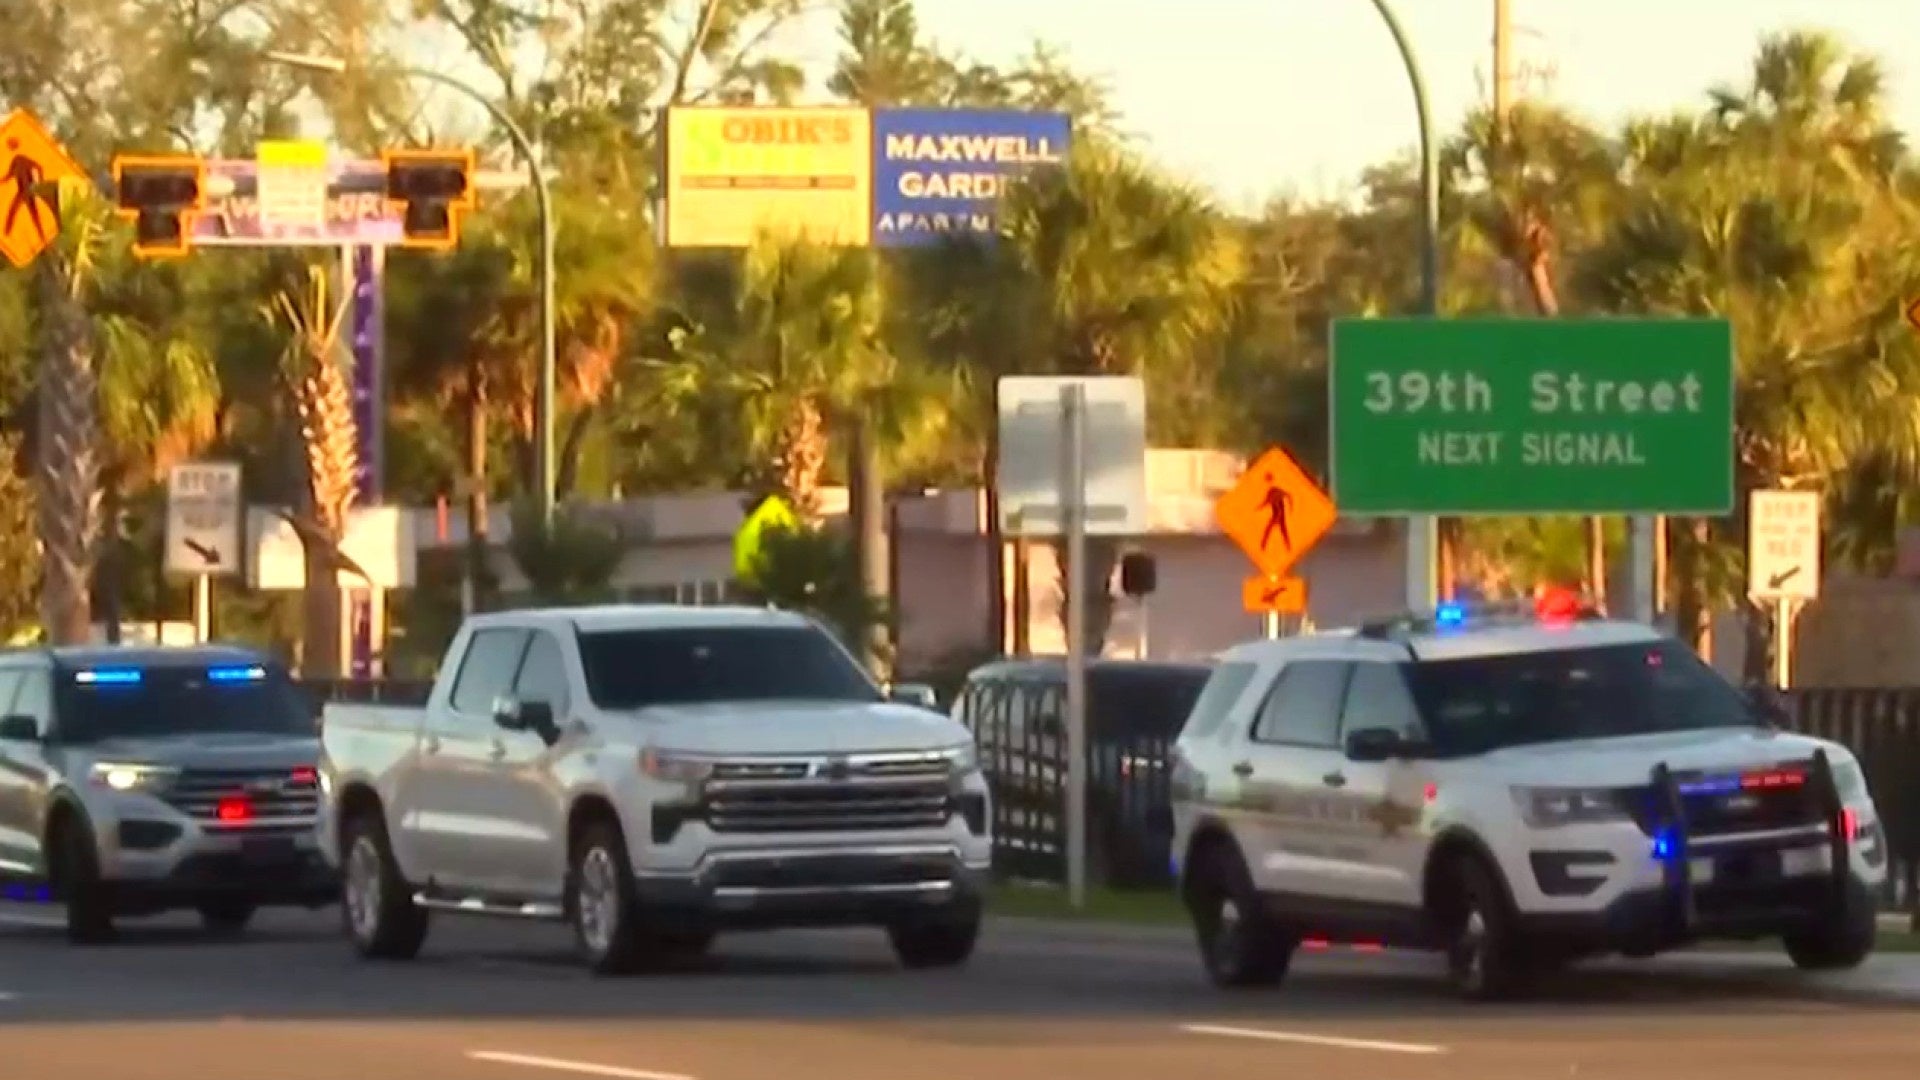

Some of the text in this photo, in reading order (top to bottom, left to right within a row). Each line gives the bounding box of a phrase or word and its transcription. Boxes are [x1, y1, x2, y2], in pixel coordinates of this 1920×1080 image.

[885, 133, 1062, 162] MAXWELL
[899, 171, 1016, 199] GARD
[1362, 370, 1703, 413] 39th Street
[1417, 430, 1646, 466] NEXT SIGNAL
